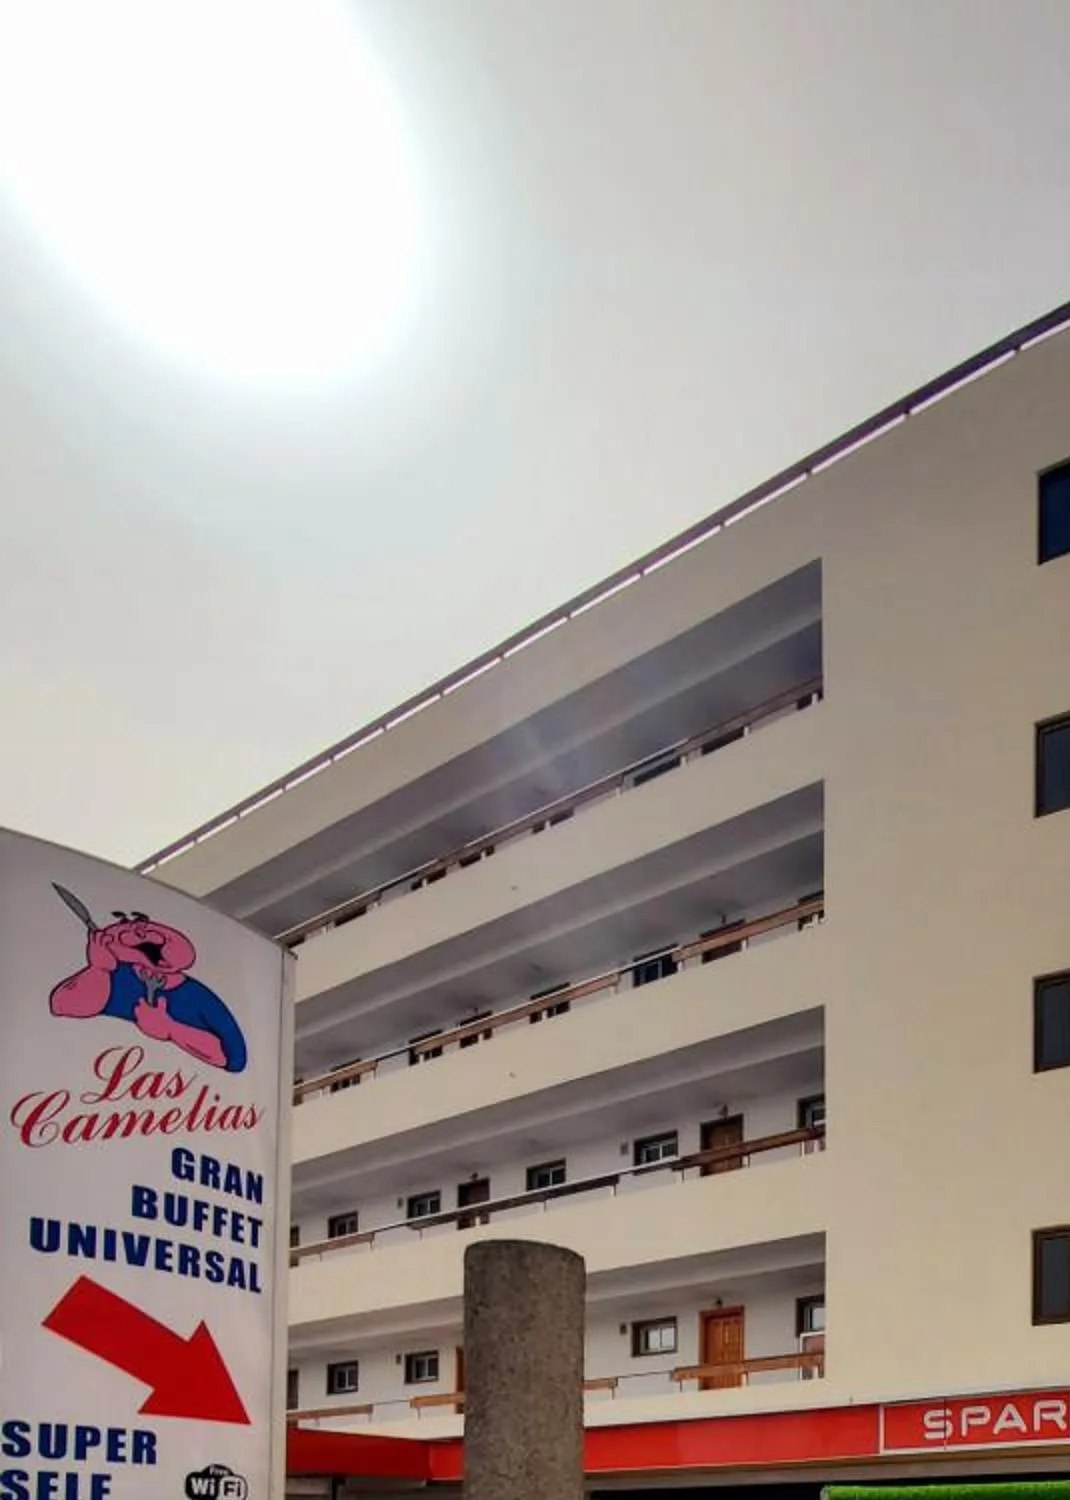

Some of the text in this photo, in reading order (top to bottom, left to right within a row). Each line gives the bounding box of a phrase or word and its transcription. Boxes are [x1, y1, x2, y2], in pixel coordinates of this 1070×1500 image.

[80, 1045, 199, 1104] Las
[11, 1085, 264, 1148] Camelias
[172, 1147, 263, 1204] GRAN
[131, 1185, 263, 1248] BUFFET
[29, 1217, 261, 1293] UNIVERSAL
[1, 1420, 157, 1464] SUPER
[922, 1399, 1067, 1440] SPAR
